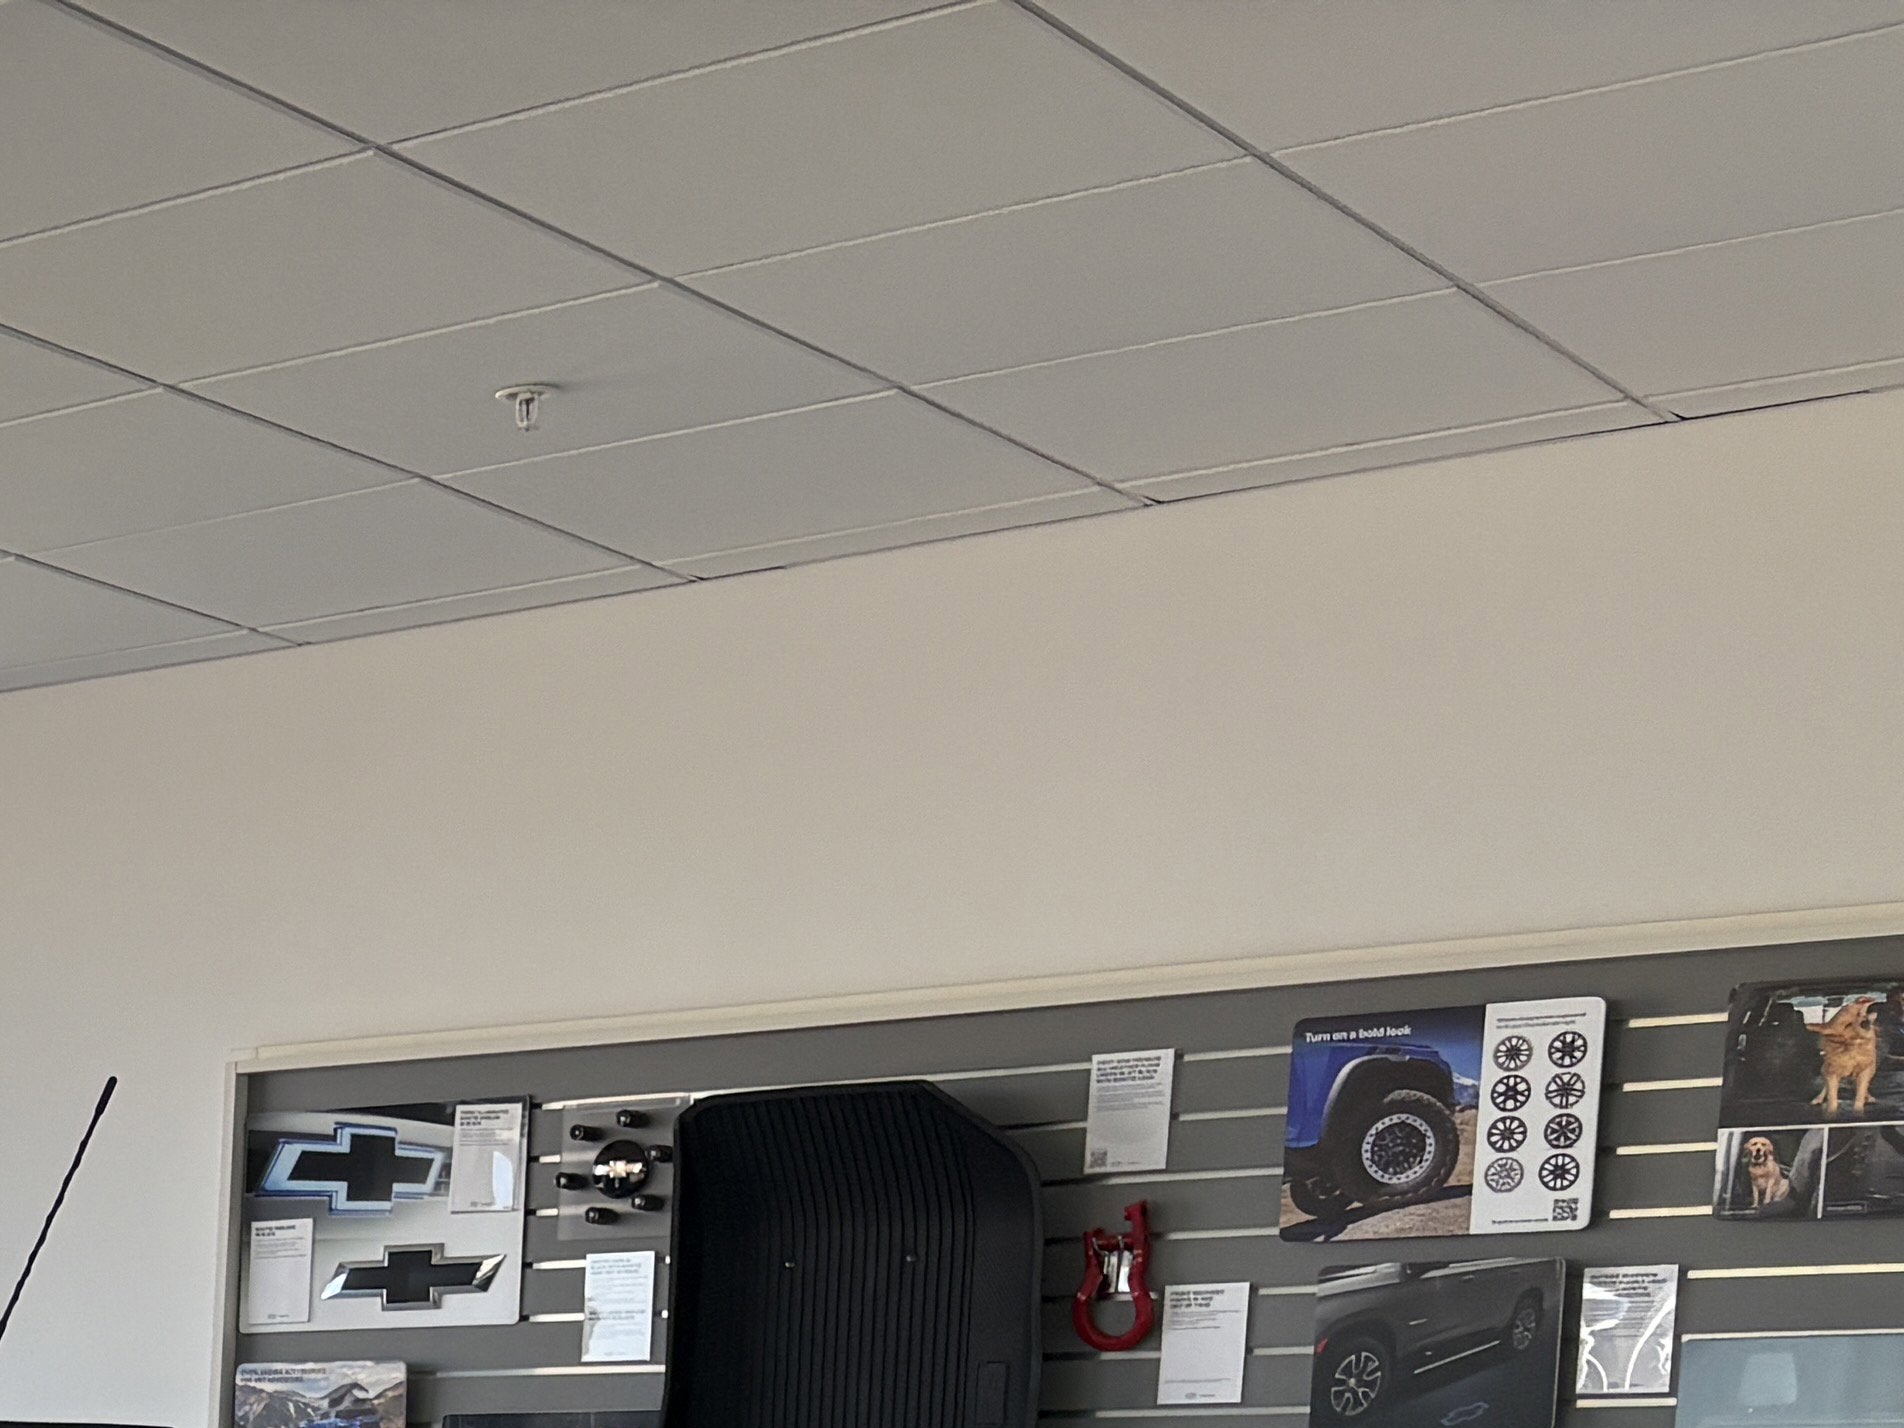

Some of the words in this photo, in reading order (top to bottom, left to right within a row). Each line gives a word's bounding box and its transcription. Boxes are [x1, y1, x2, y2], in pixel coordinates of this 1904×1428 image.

[1305, 1032, 1330, 1043] Turn
[1332, 1031, 1348, 1041] on
[1349, 1031, 1356, 1040] a
[1358, 1027, 1384, 1039] bold
[1386, 1024, 1411, 1037] look
